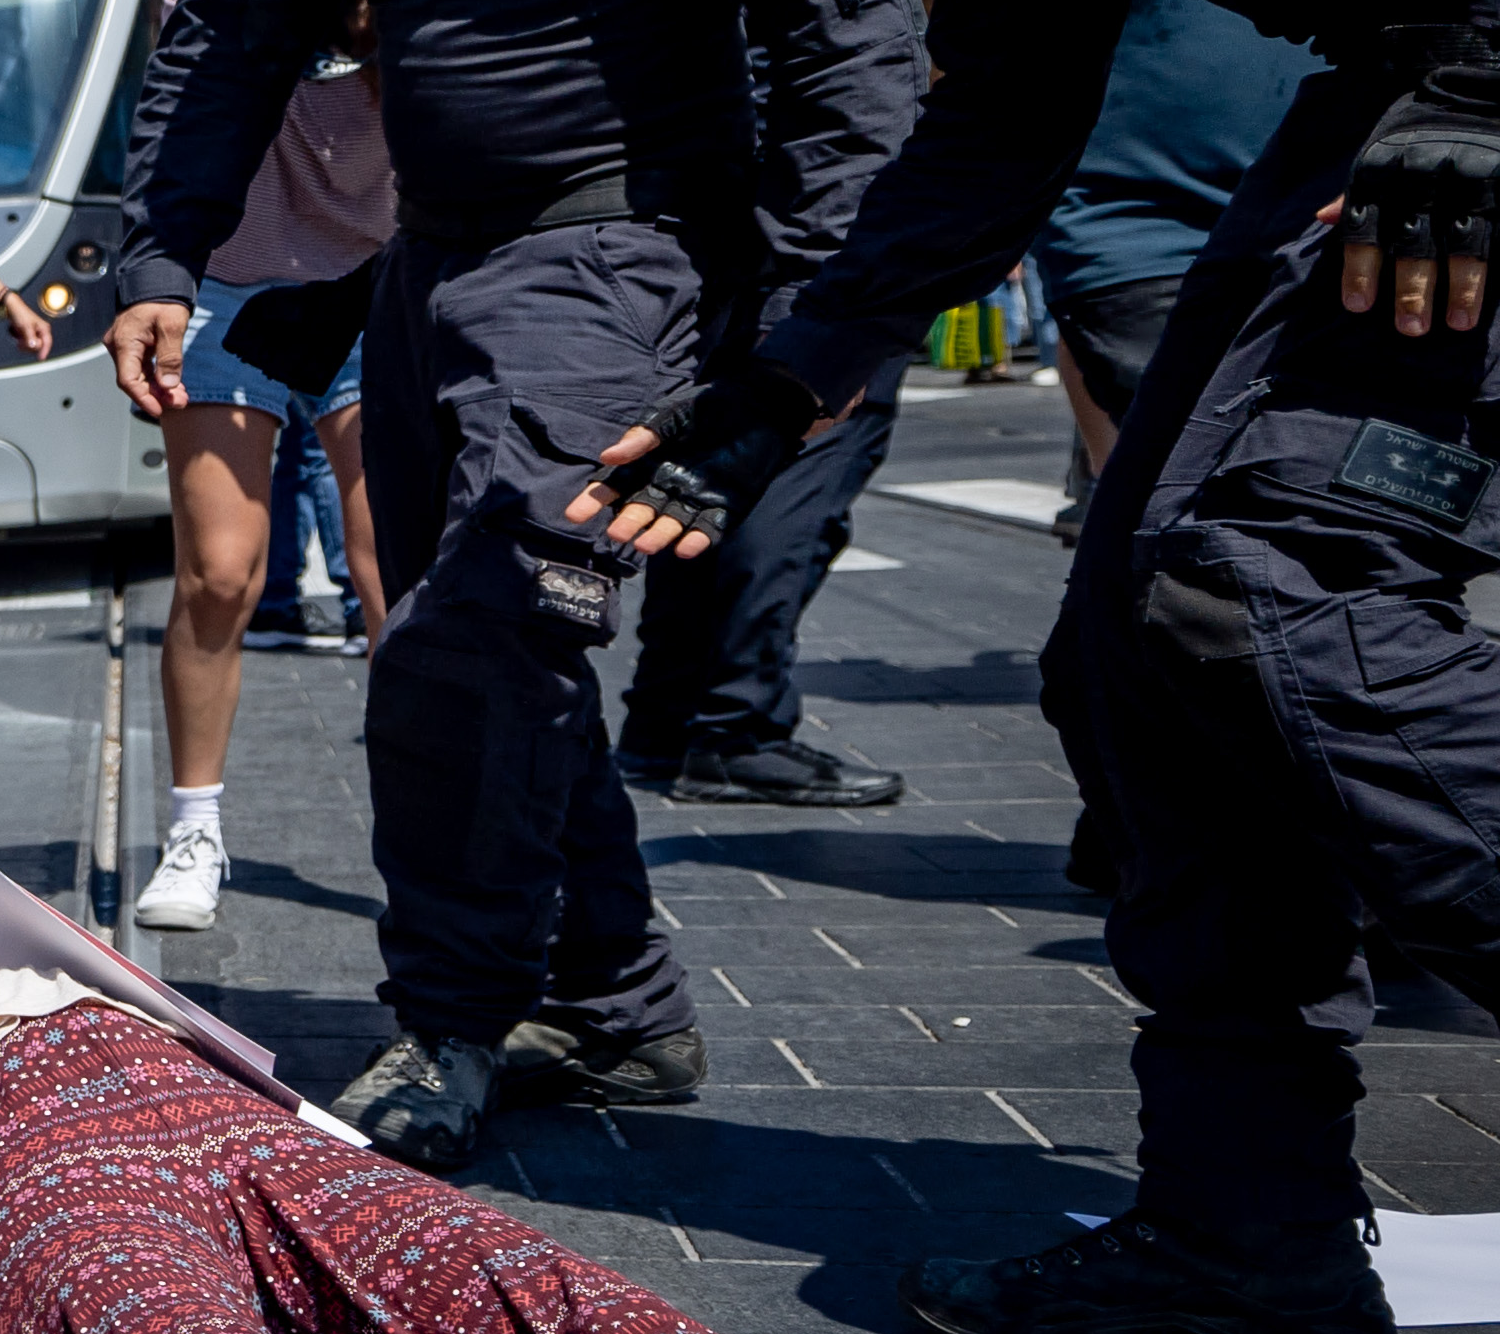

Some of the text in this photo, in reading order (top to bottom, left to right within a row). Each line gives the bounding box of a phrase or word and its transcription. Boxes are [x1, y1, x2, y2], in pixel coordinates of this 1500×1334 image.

[1385, 430, 1480, 473] משטרת ישראל
[1364, 473, 1422, 498] ירושלים
